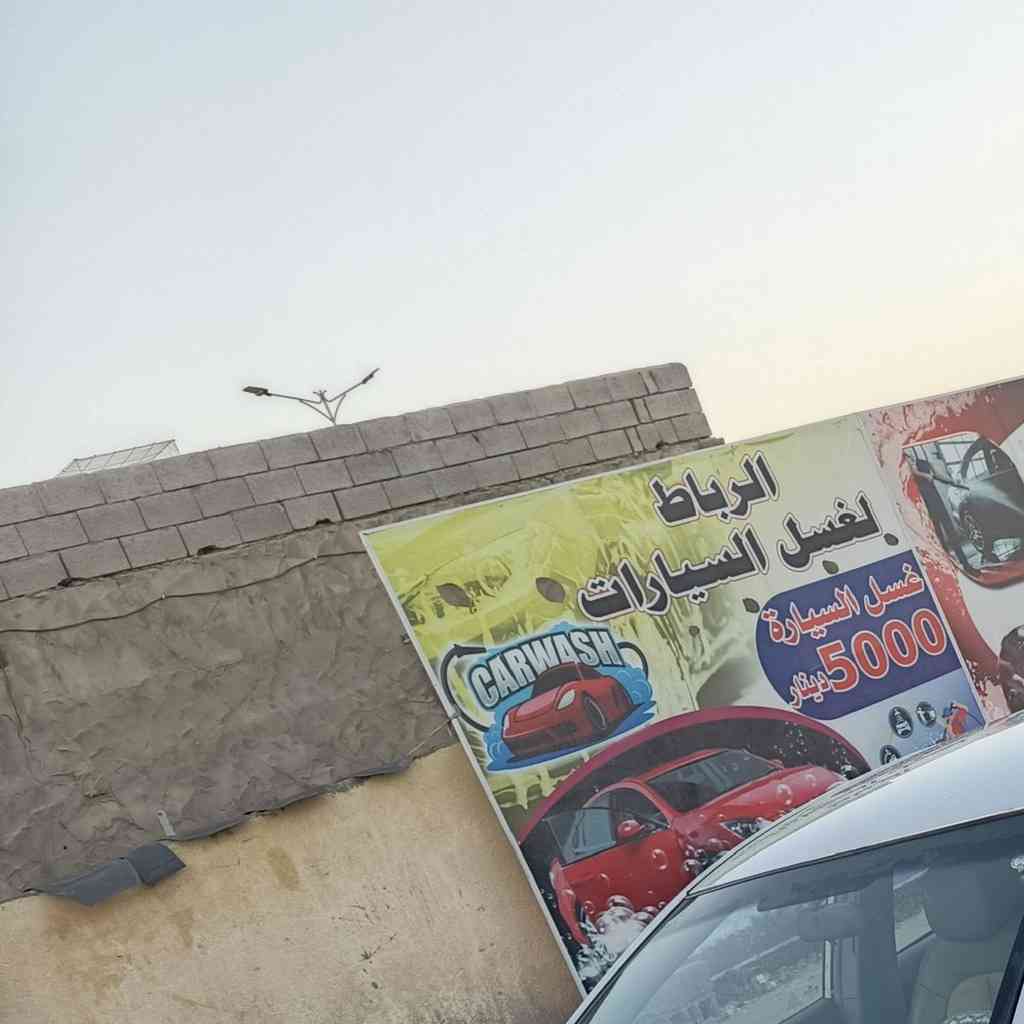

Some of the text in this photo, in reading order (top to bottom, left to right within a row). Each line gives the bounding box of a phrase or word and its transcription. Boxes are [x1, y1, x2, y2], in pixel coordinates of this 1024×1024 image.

[652, 452, 778, 525] الرباط
[578, 491, 882, 621] لغسل السيارات
[761, 563, 925, 645] غسل السيارة
[470, 628, 625, 709] CARWASH
[817, 608, 947, 693] 5000
